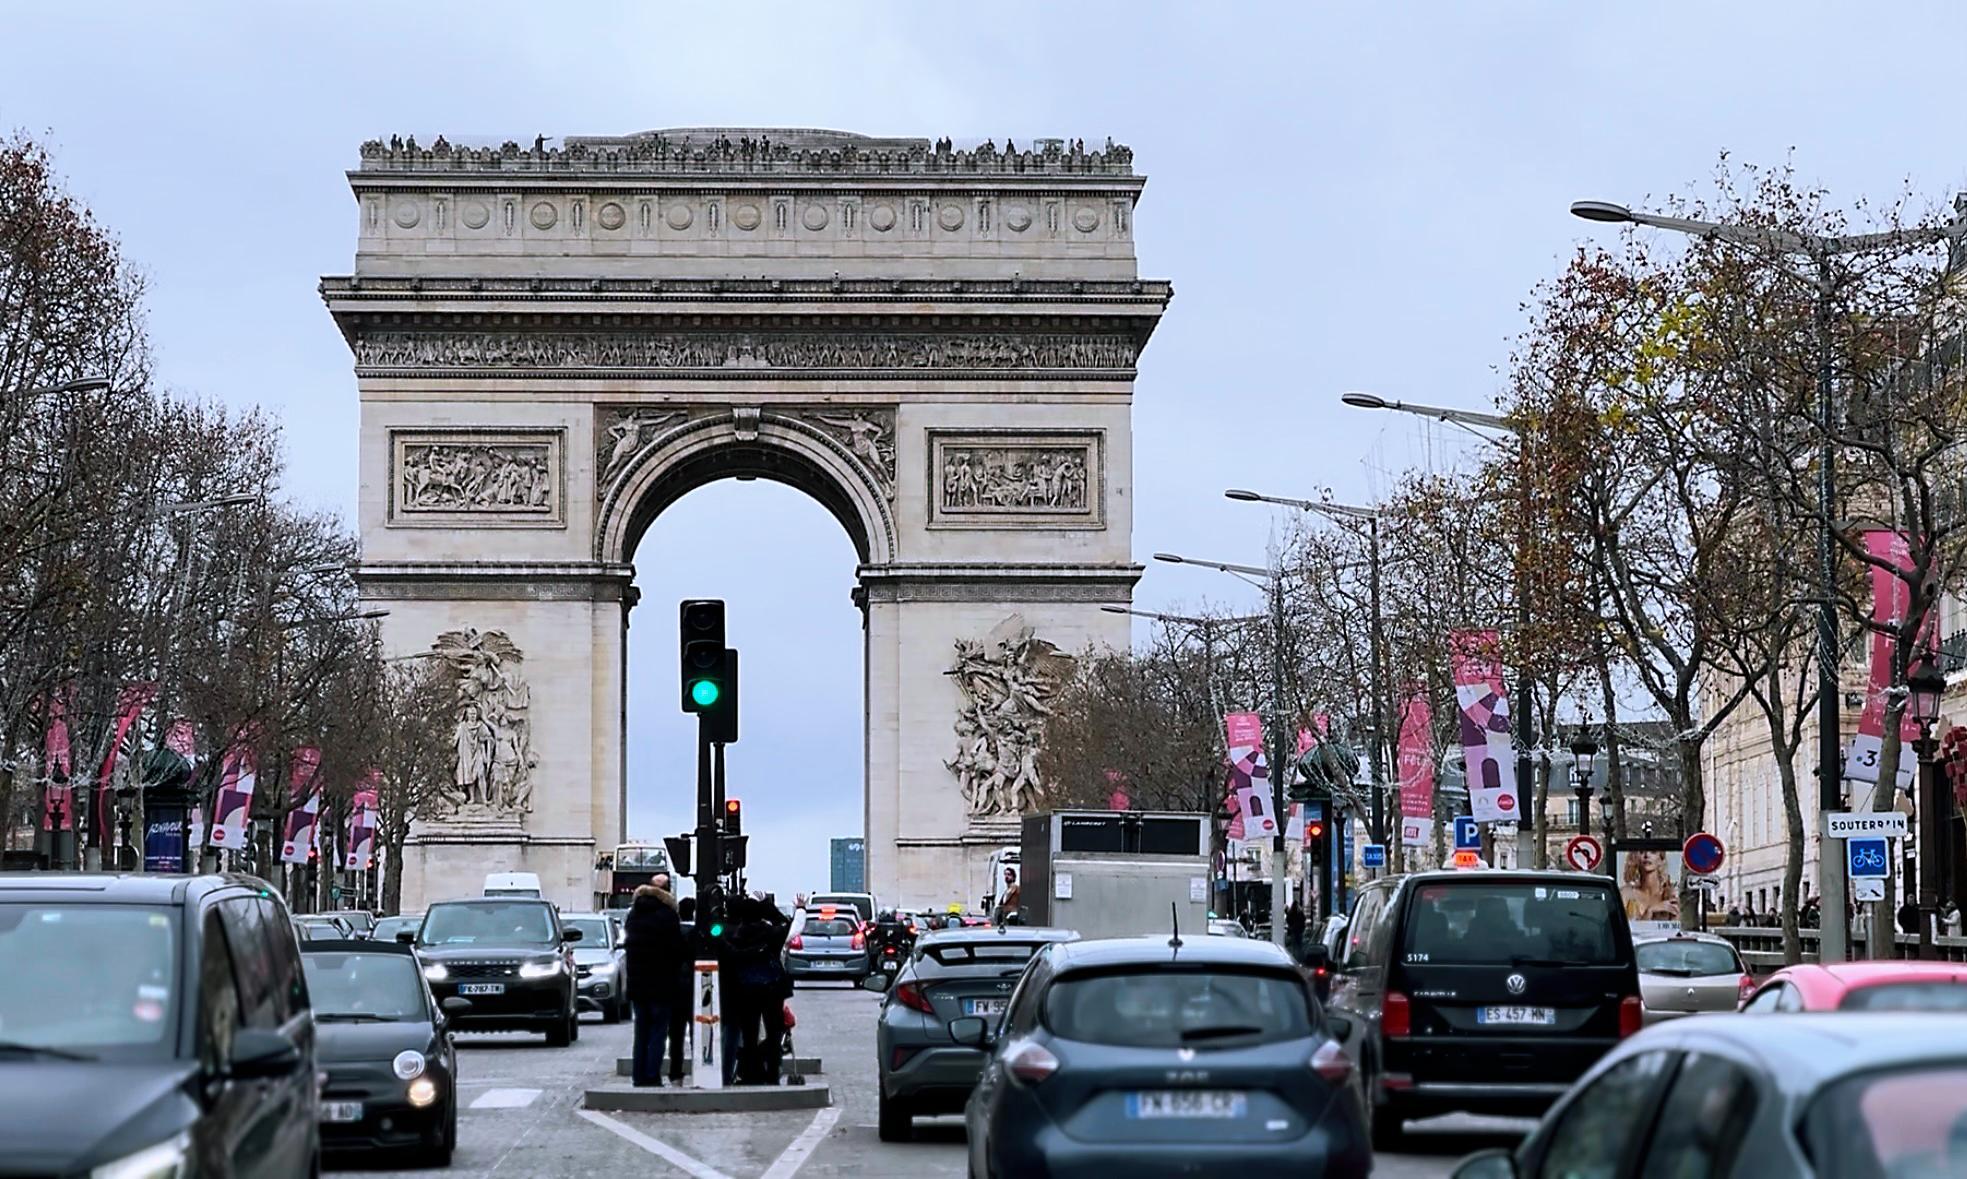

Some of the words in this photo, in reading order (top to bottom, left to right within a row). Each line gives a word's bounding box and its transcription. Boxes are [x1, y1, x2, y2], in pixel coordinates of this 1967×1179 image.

[1465, 823, 1478, 843] P
[975, 1001, 989, 1013] FW
[1487, 1008, 1500, 1019] ES
[1506, 1008, 1526, 1019] 457
